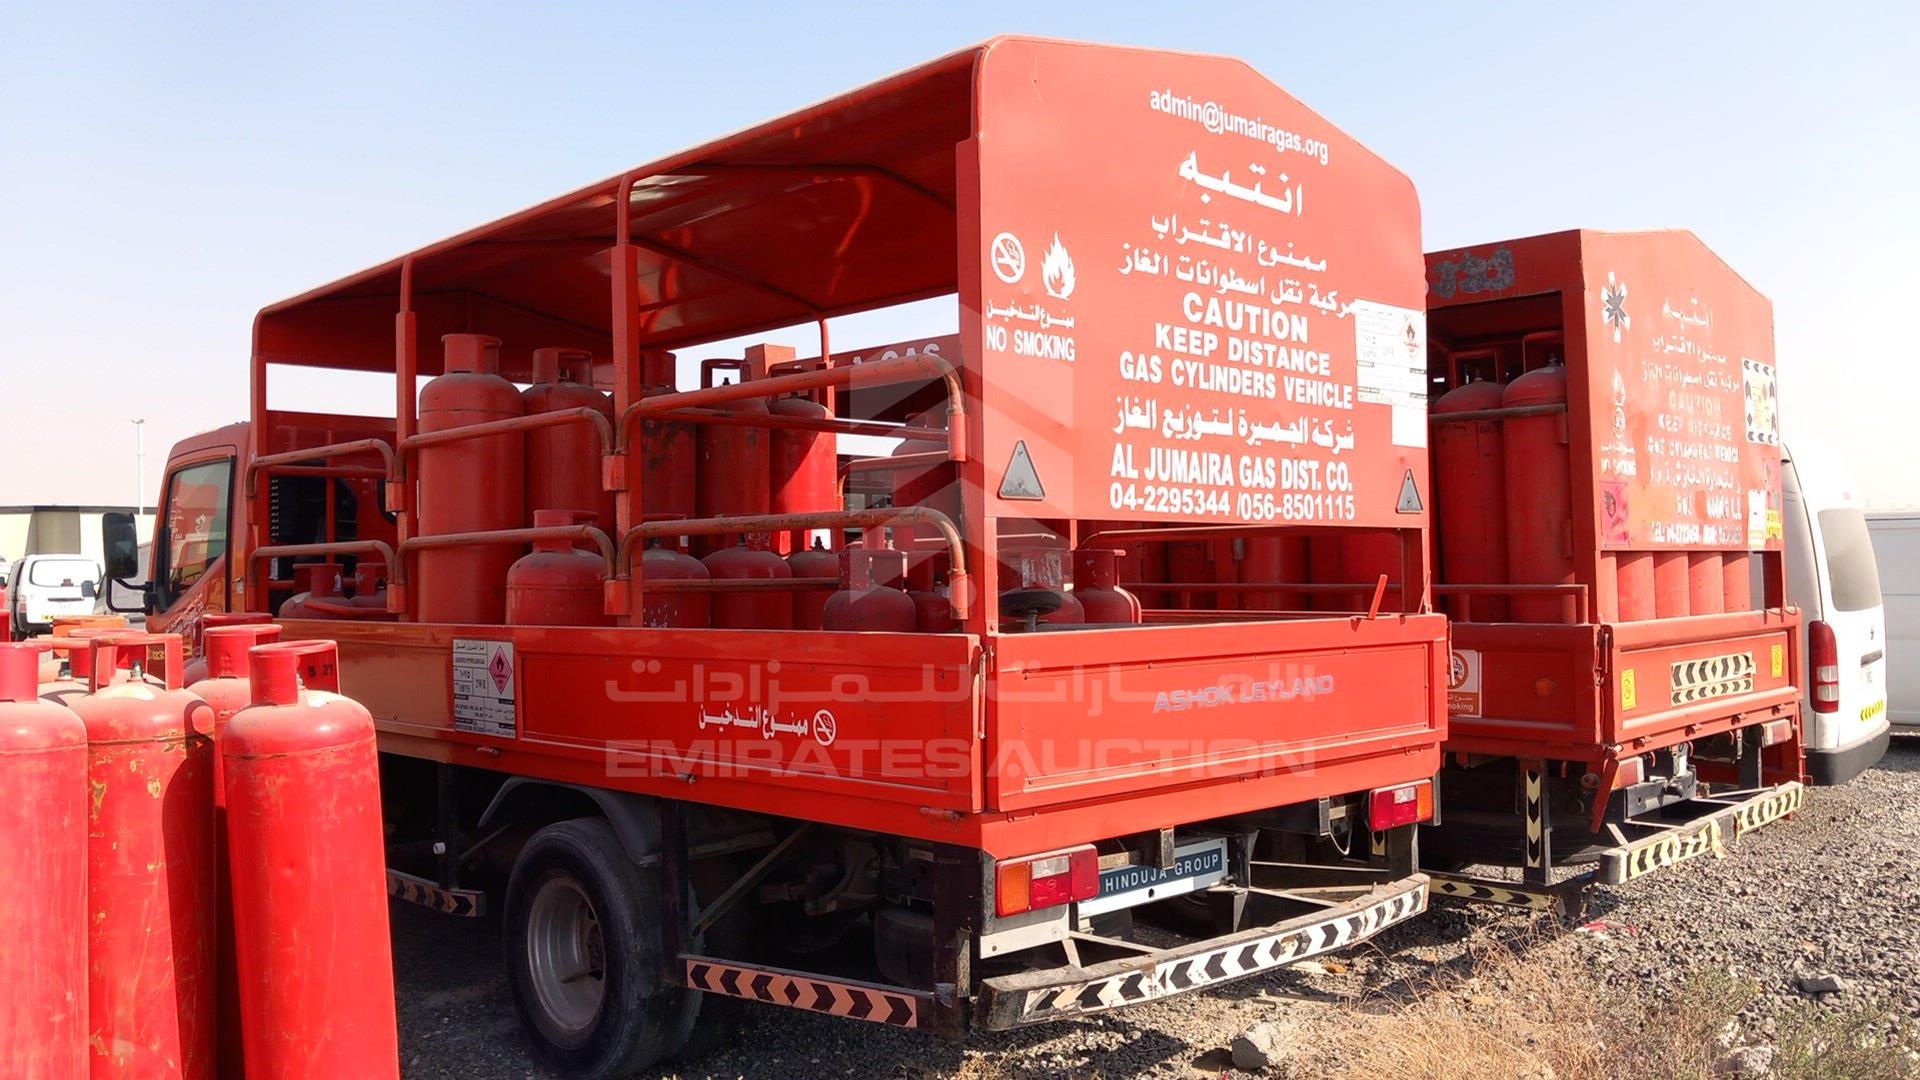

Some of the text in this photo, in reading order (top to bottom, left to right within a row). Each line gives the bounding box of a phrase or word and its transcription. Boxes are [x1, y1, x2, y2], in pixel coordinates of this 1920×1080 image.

[1149, 88, 1329, 166] admin@jumairagas.org
[1178, 149, 1303, 217] انتبه
[1117, 242, 1169, 277] الغاز
[1151, 213, 1328, 272] ممنوع الاقتراب
[1175, 254, 1265, 296] اسطوانات
[1270, 278, 1303, 305] نقل
[1182, 291, 1308, 343] CAUTION
[986, 325, 1076, 362] NO SMOKING
[1155, 321, 1331, 377] KEEP DISTANCE
[1119, 350, 1354, 411] GAS CYLINDERS VEHICLE
[1112, 395, 1158, 435] الغاز
[1162, 402, 1235, 442] لتوزيع
[1311, 415, 1355, 455] شركة
[1110, 443, 1354, 493] AL JUMAIRA GAS DIST. CO.
[1110, 482, 1356, 521] 04-2295344 /056-8501115
[1153, 674, 1335, 714] ASHOK LEYLAND
[1447, 702, 1474, 712] moking
[699, 701, 809, 740] ممنوع التدخين
[1105, 853, 1219, 893] HINDUJA GROUP
